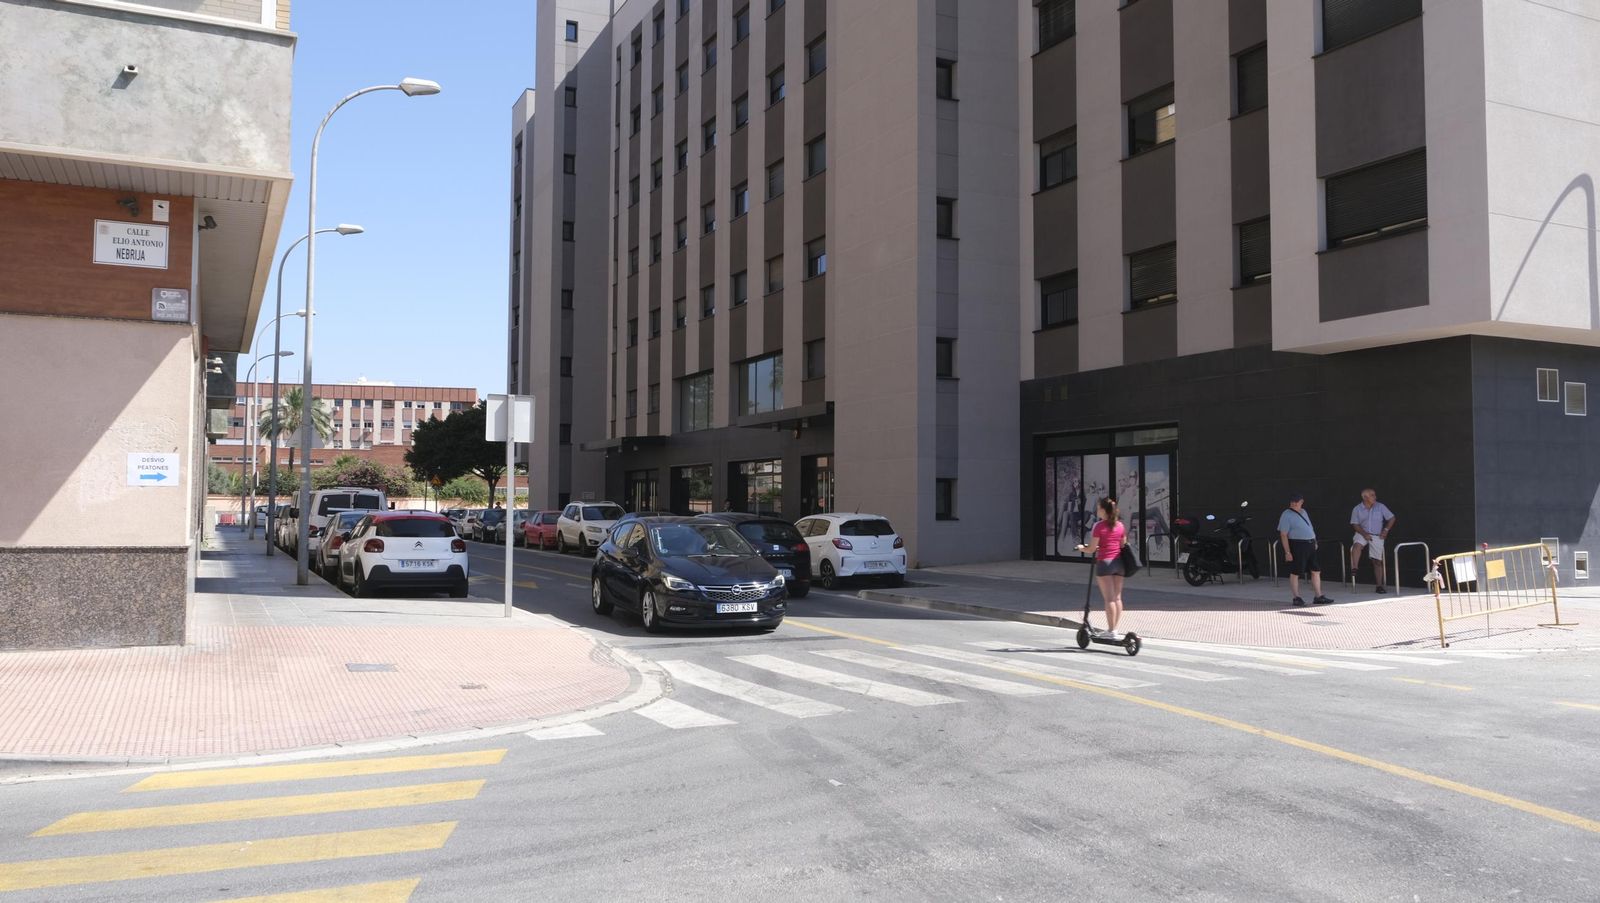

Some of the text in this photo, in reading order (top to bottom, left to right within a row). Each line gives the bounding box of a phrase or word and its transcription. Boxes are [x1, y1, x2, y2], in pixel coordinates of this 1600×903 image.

[127, 228, 150, 236] CALLE
[112, 237, 164, 248] ELIO ANTONIO
[116, 248, 146, 261] NEBRIJA
[721, 603, 755, 612] 6380 KSV
